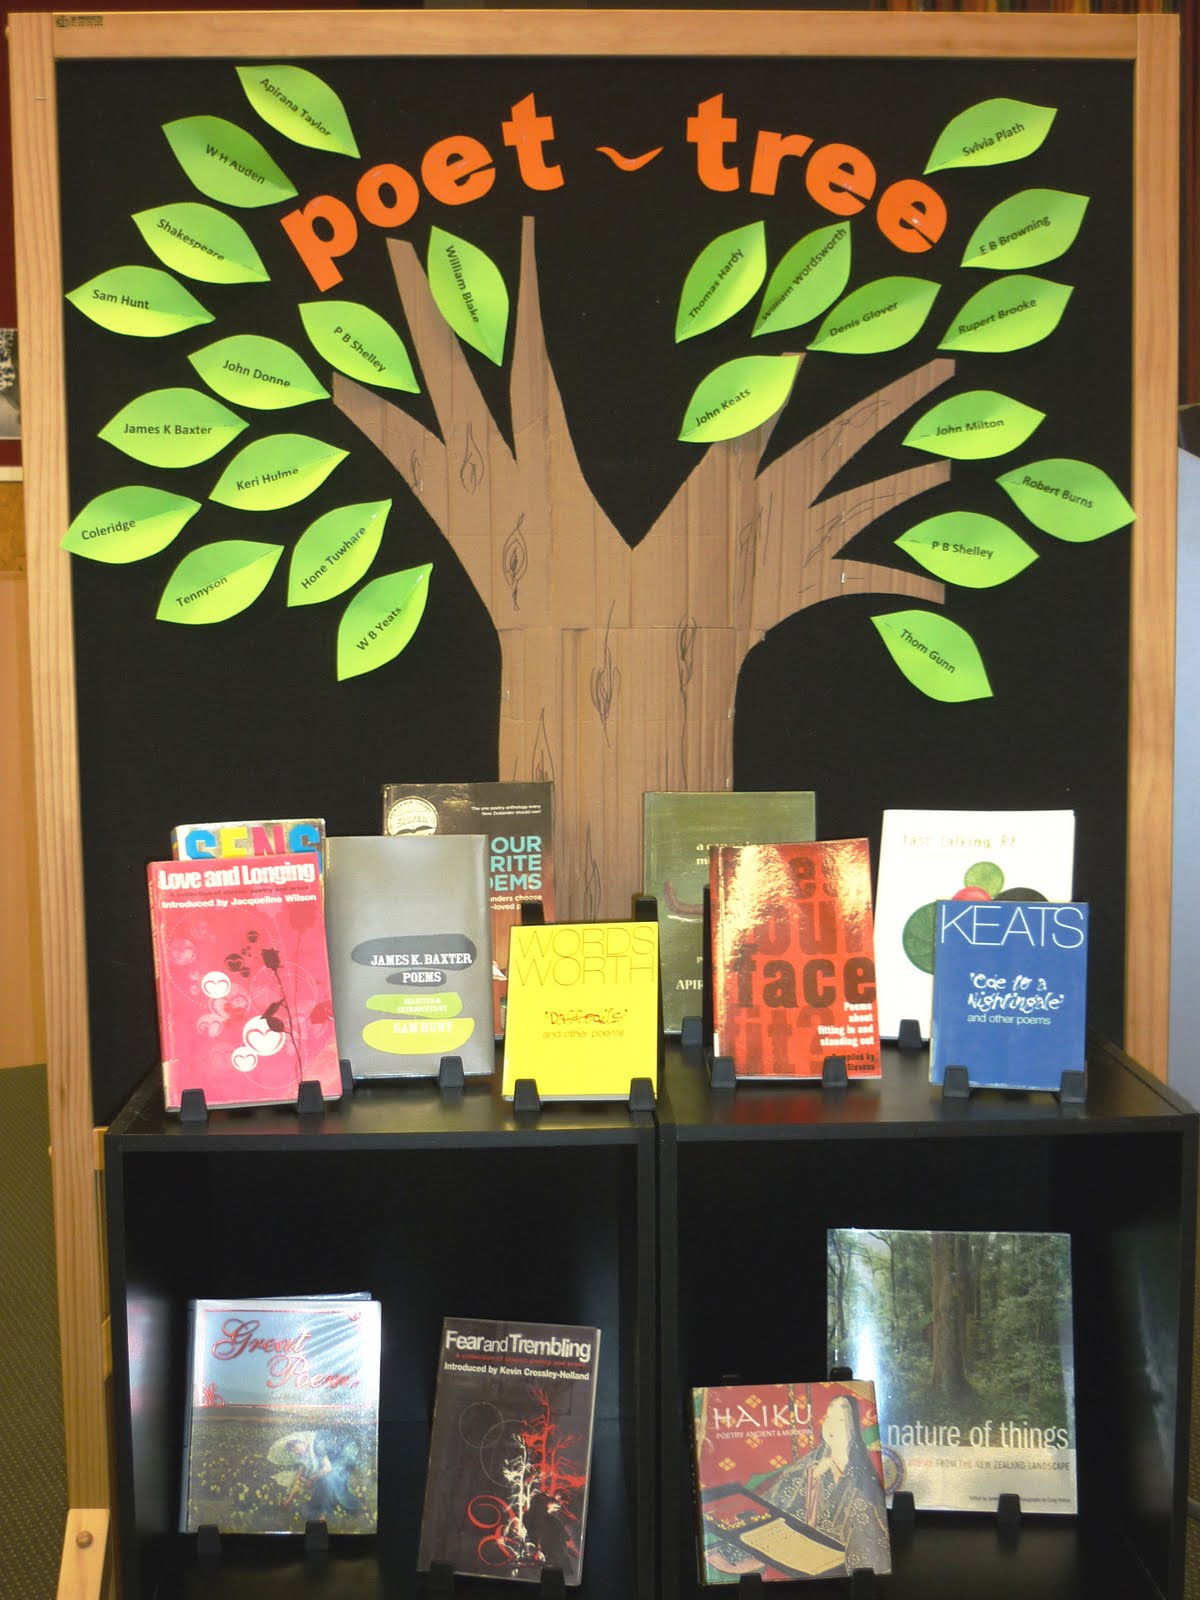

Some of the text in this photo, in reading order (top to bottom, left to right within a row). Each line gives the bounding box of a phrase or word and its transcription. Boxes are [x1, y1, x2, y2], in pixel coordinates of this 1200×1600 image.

[259, 78, 332, 137] Apirana Taylor
[962, 122, 1025, 157] Sylvia Plath
[205, 144, 266, 185] W H Auden
[279, 92, 947, 293] poet tree
[156, 219, 225, 262] Shakespeare
[979, 215, 1052, 255] E B Browning
[793, 228, 847, 286] Wordsworth
[446, 245, 480, 324] William Blake
[688, 248, 744, 319] Thomas Hardy
[93, 289, 150, 310] Sam Hunt
[829, 301, 899, 337] Denis Glover
[958, 299, 1037, 335] Rupert Brooke
[333, 326, 388, 373] P B Shelley
[222, 359, 291, 388] John Donne
[694, 388, 751, 427] John Keats
[124, 423, 213, 435] James K Baxter
[936, 418, 1005, 437] John Milton
[236, 467, 299, 491] Keri Hulme
[1022, 476, 1094, 510] Robert Burns
[81, 518, 137, 541] Coleridge
[300, 526, 367, 590] Hone Tuwhare
[931, 540, 994, 560] P B Shelley
[176, 576, 229, 608] Tennyson
[356, 605, 403, 652] W B Yeats
[900, 628, 956, 674] Thom Gunn
[491, 835, 542, 854] OUR
[158, 862, 315, 890] Love and Longing
[490, 873, 542, 891] EMS
[161, 894, 316, 909] Introduced by Jacqueline Wilson
[518, 926, 655, 958] WORDS
[941, 905, 1084, 948] KEATS
[370, 952, 472, 966] JAMES K. BAXTER
[516, 956, 655, 987] WORTH
[402, 971, 442, 983] POEMS
[731, 943, 877, 1008] face
[1037, 978, 1048, 991] a
[843, 1002, 873, 1011] Poems
[848, 1013, 873, 1022] about
[967, 1014, 1051, 1026] and other poems
[543, 1027, 625, 1039] and other poems
[817, 1024, 874, 1036] fitting in and
[820, 1036, 875, 1048] standing out
[212, 1318, 312, 1360] Great
[445, 1330, 485, 1351] Fear
[484, 1336, 508, 1353] and
[509, 1333, 591, 1363] Trembling
[444, 1362, 590, 1380] Introduced by Kevin Crossley-Holland
[713, 1403, 812, 1430] HAIKU
[716, 1431, 744, 1439] POETRY
[746, 1429, 777, 1438] ANCIENT
[888, 1420, 1069, 1455] nature of things
[975, 1460, 991, 1469] NEW
[993, 1460, 1026, 1470] ZEALAND
[1028, 1461, 1070, 1471] LANDSCAPE
